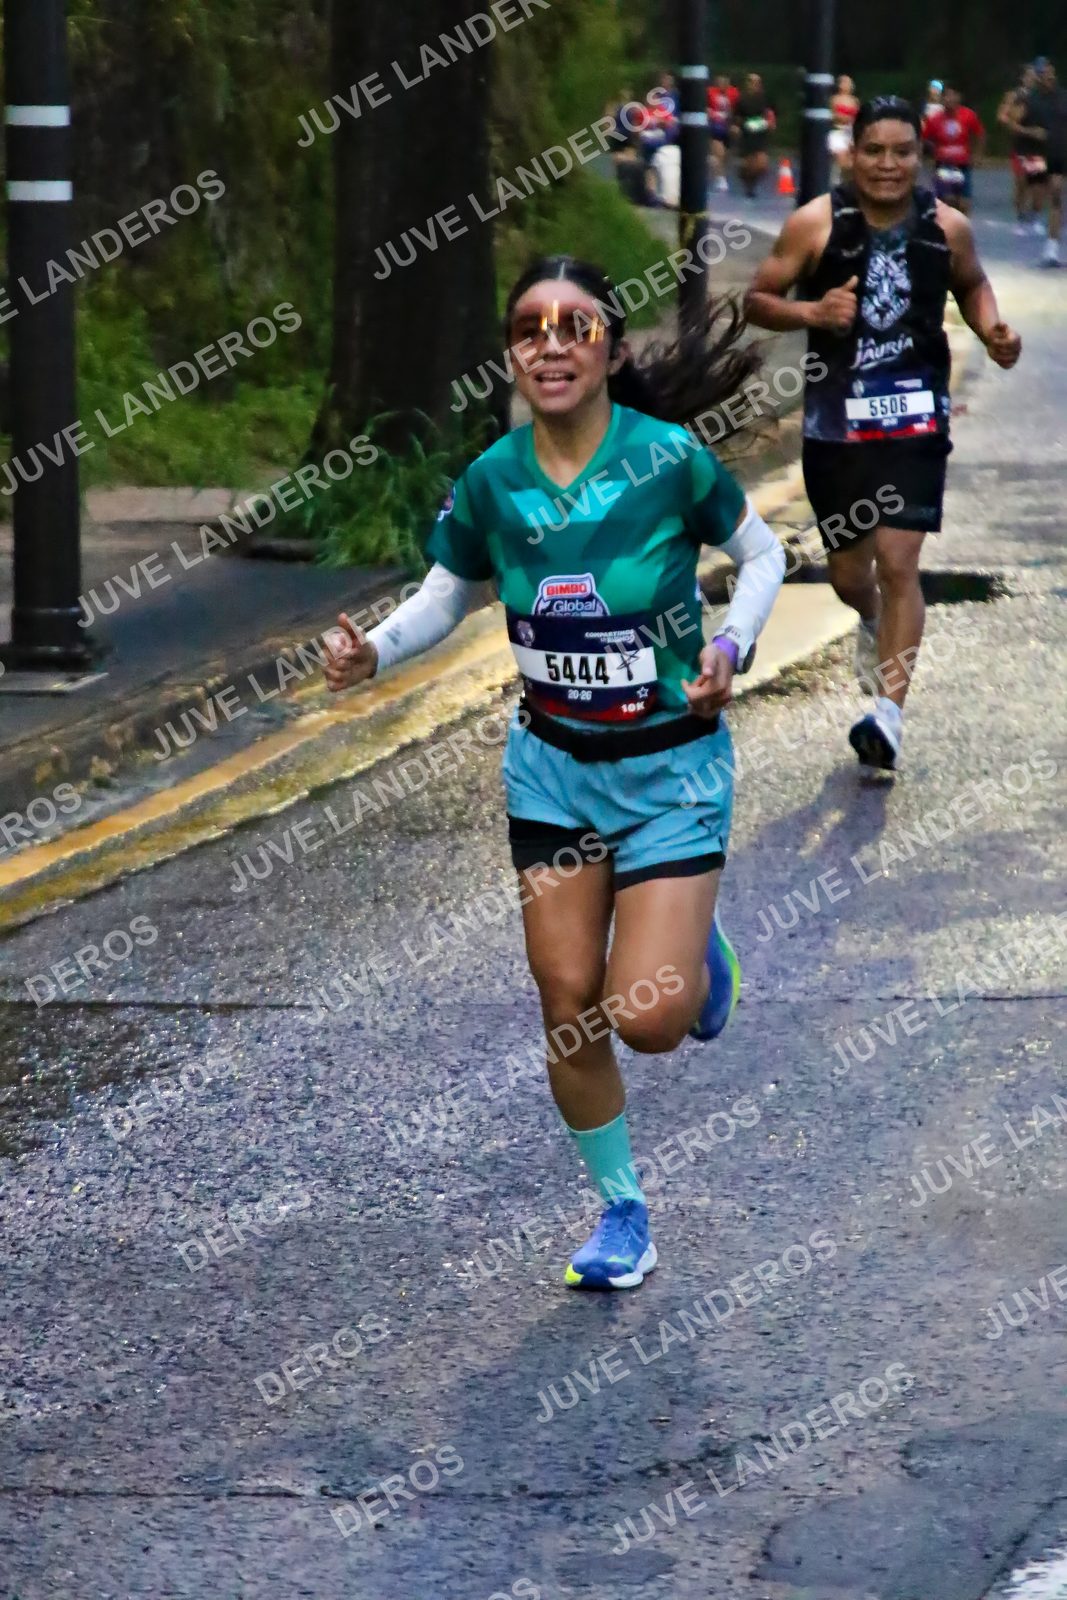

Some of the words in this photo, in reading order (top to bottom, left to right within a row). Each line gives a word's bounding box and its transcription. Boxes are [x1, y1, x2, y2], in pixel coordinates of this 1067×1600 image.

[869, 395, 908, 416] 5506
[546, 583, 587, 596] BIMBO
[553, 599, 596, 612] Global
[545, 653, 610, 684] 5444
